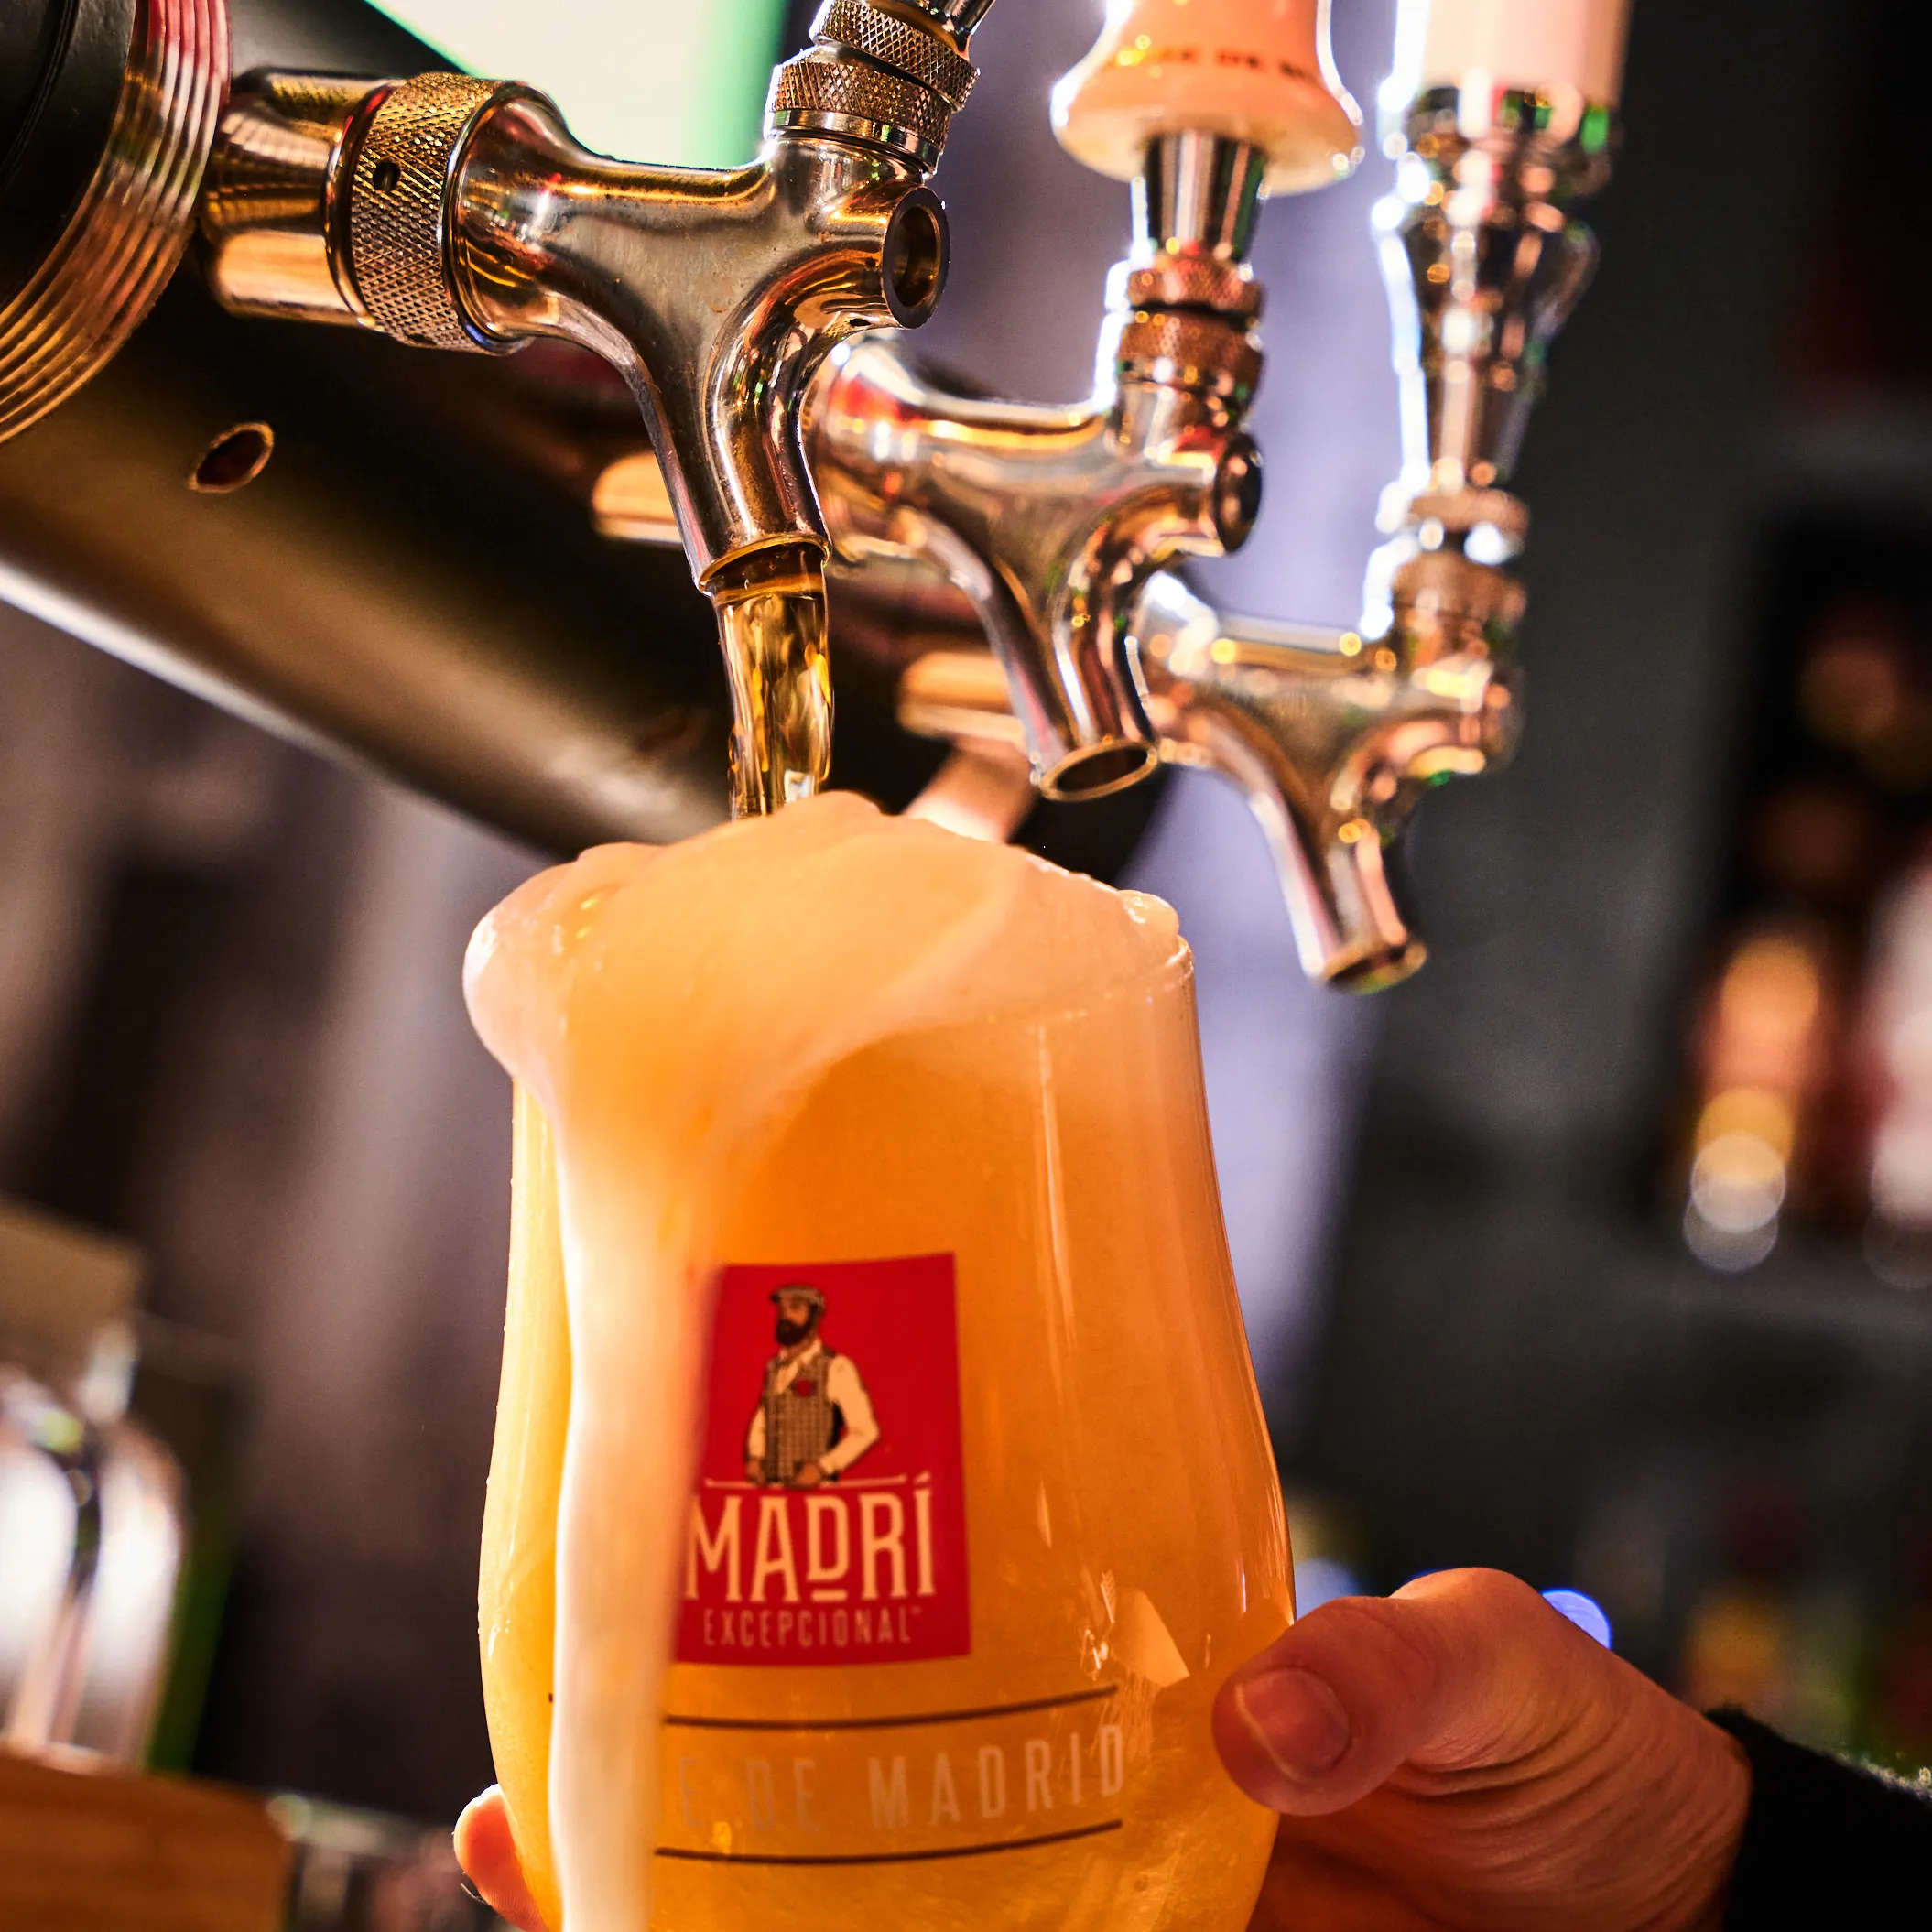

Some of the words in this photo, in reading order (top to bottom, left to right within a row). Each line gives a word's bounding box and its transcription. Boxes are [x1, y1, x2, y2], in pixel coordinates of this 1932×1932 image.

[685, 1471, 935, 1602] MADRÍ
[702, 1605, 913, 1648] EXCEPCIONAL
[745, 1757, 820, 1831] DE
[868, 1724, 1124, 1829] MADRID
